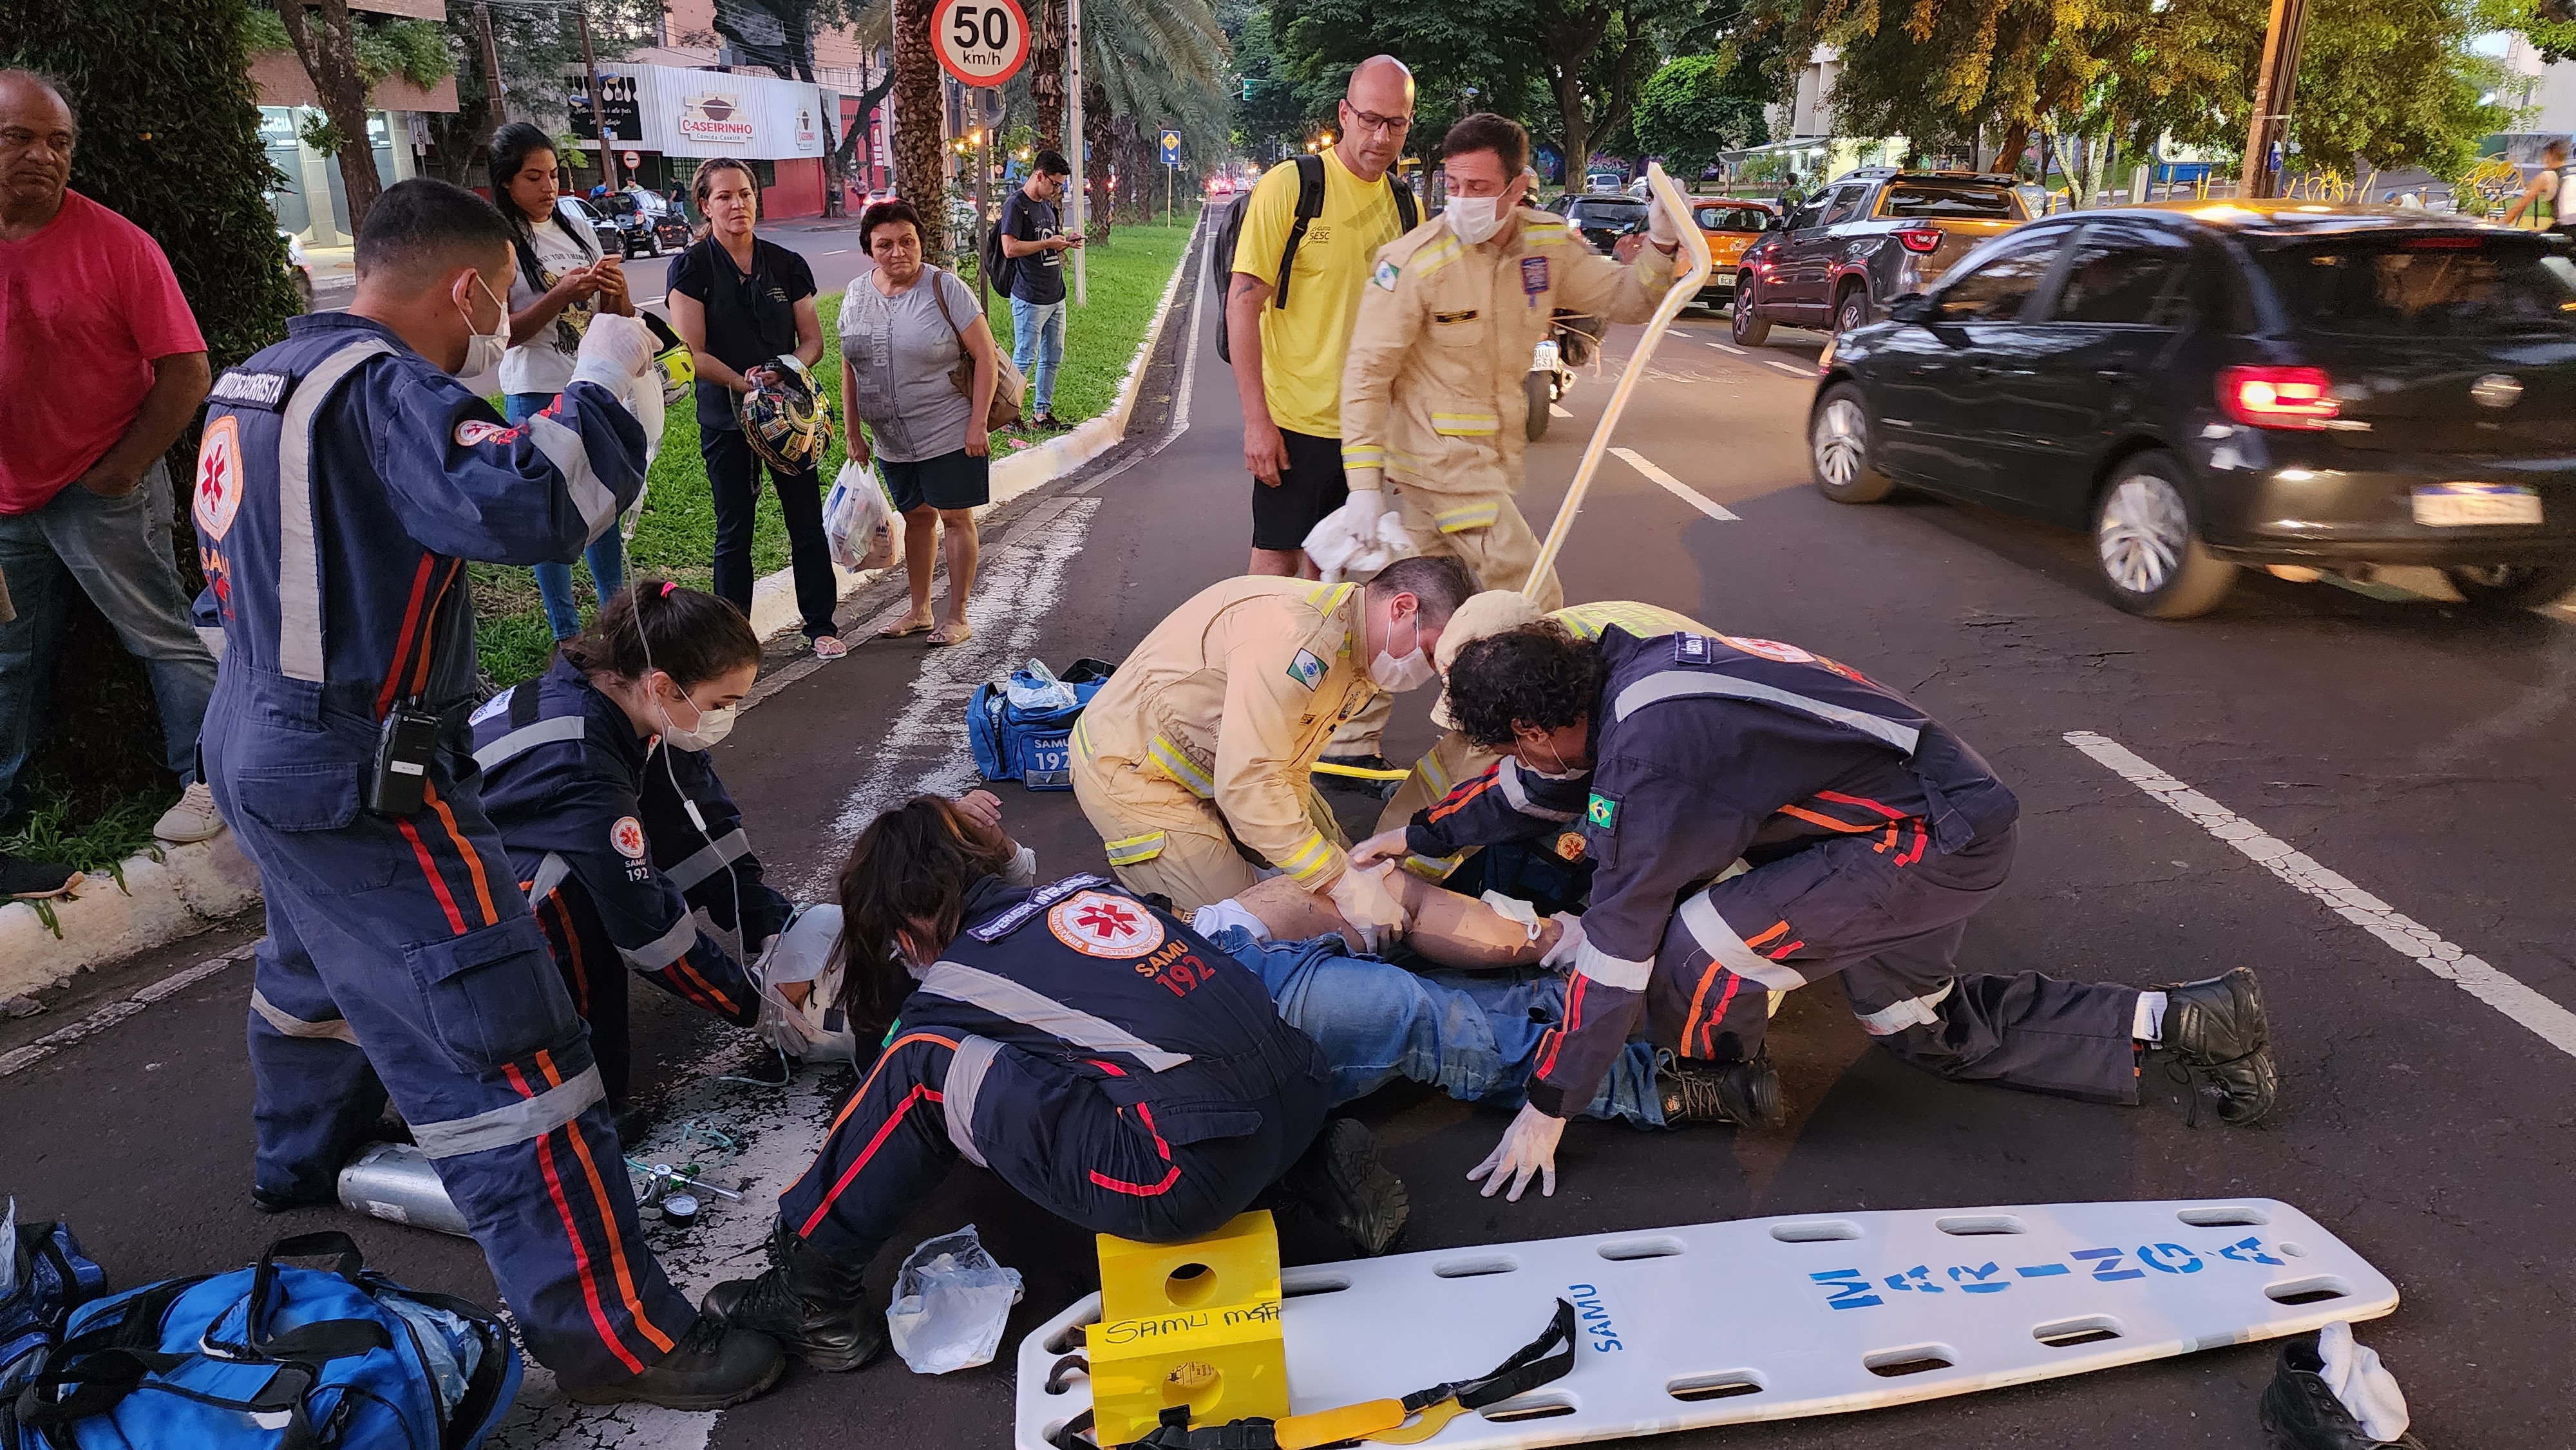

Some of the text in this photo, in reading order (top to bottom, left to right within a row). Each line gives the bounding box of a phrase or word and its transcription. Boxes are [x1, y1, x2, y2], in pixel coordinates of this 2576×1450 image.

[953, 6, 1009, 50] 50
[963, 50, 1001, 66] km/h
[682, 119, 753, 135] CASEIRINHO
[1309, 231, 1331, 240] SESC
[871, 323, 888, 367] CUSTOM
[1034, 738, 1069, 749] SAMU
[1034, 751, 1072, 771] 192
[625, 858, 647, 869] SAMU
[626, 867, 650, 881] 192
[1134, 938, 1190, 978] SAMU
[1155, 954, 1217, 998] 192
[1567, 1283, 1624, 1353] SAMU
